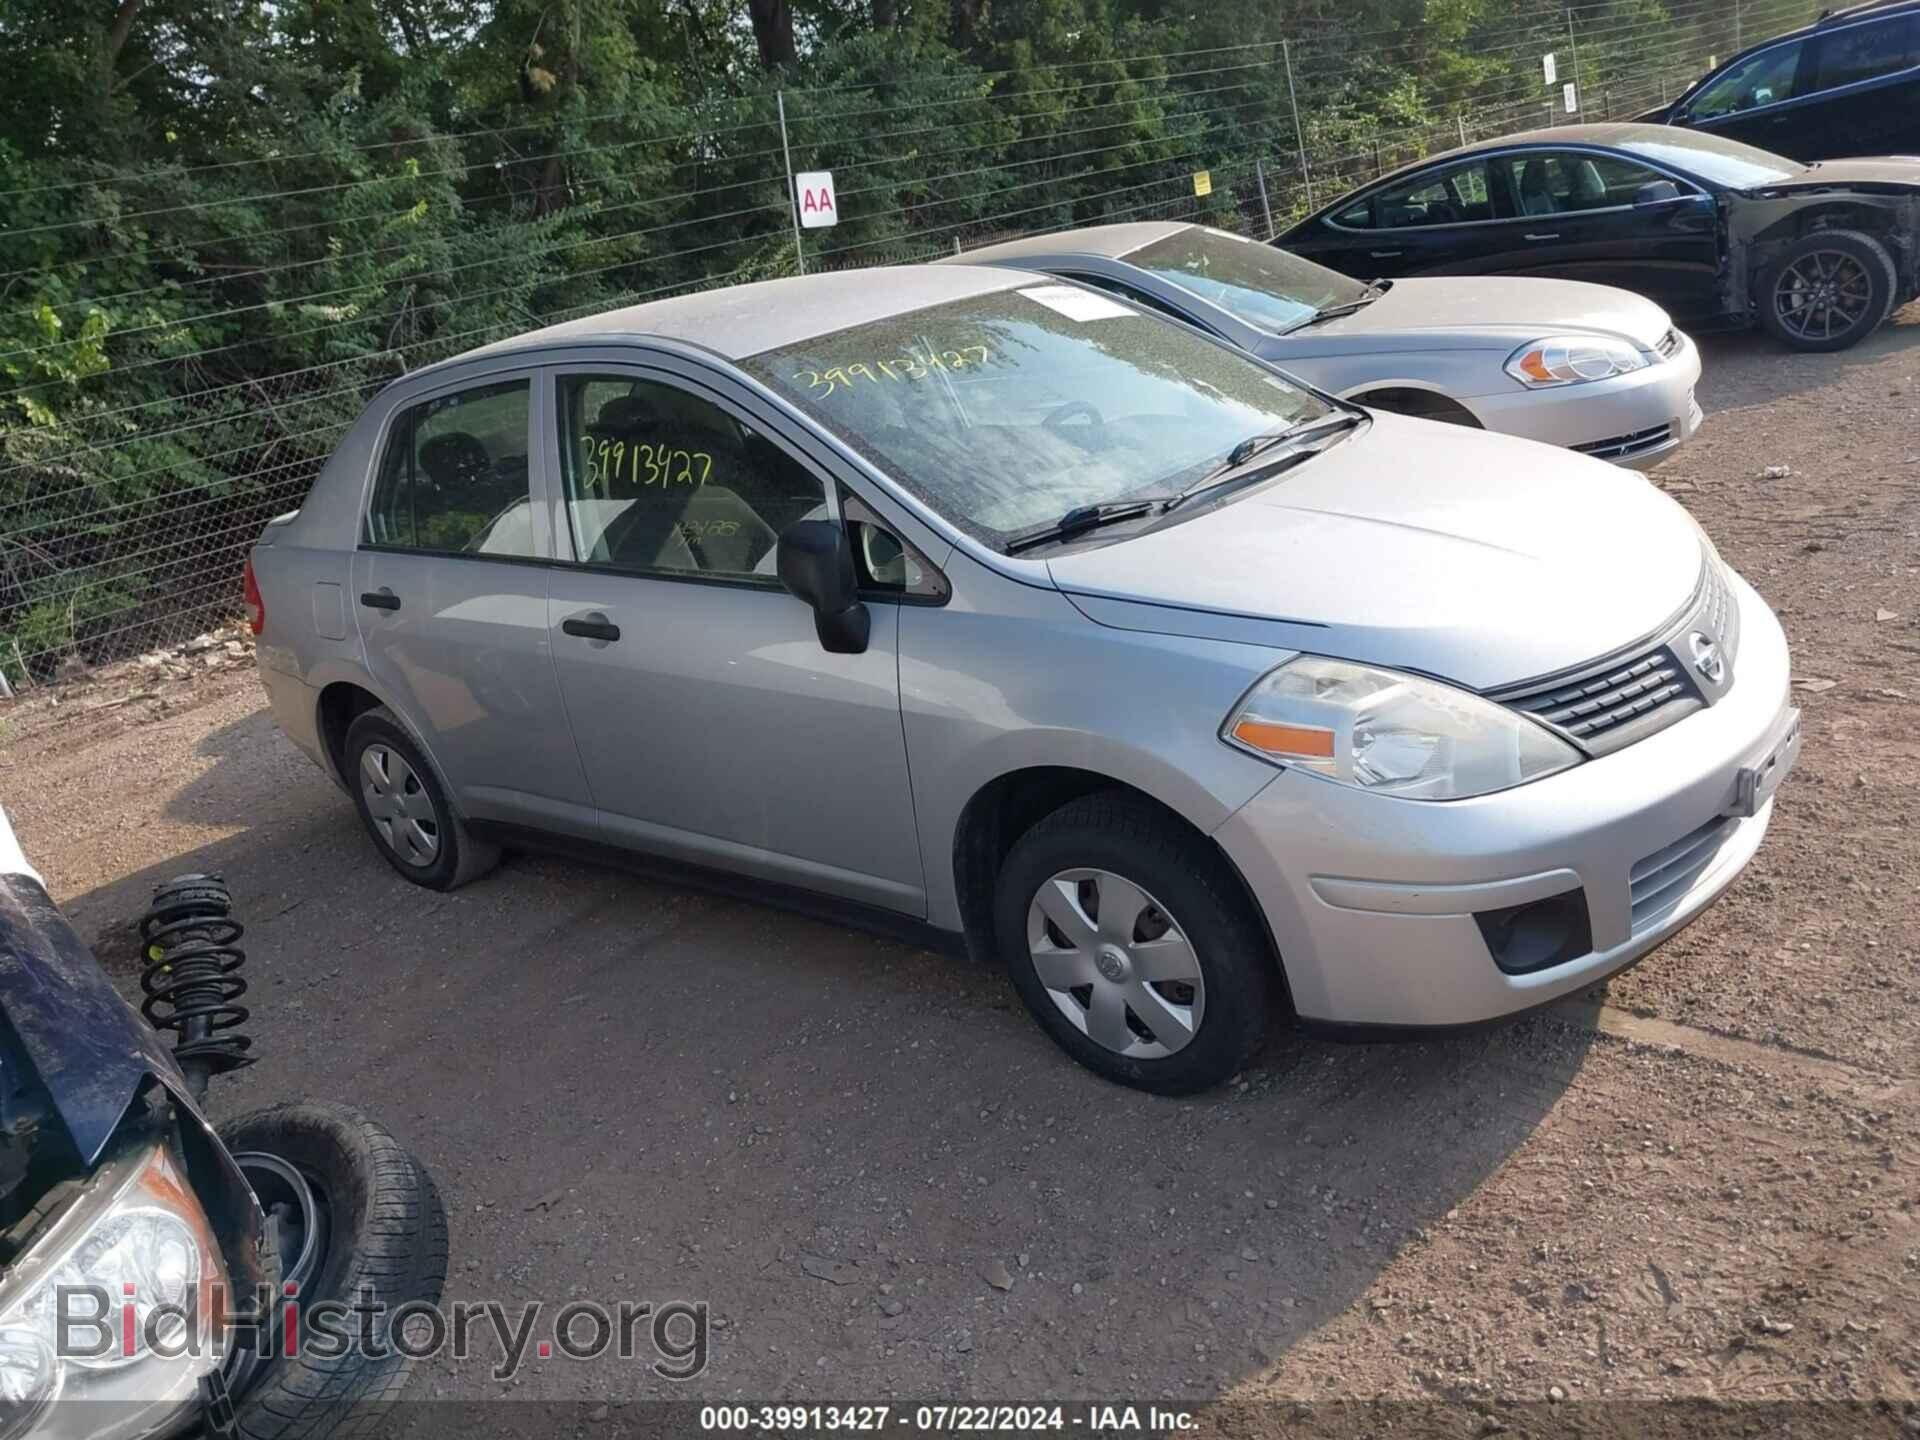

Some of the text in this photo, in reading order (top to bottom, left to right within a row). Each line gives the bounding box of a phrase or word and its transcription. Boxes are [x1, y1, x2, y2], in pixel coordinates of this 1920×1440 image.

[804, 188, 833, 212] AA
[792, 346, 988, 401] 39913427
[581, 435, 712, 489] 39913427
